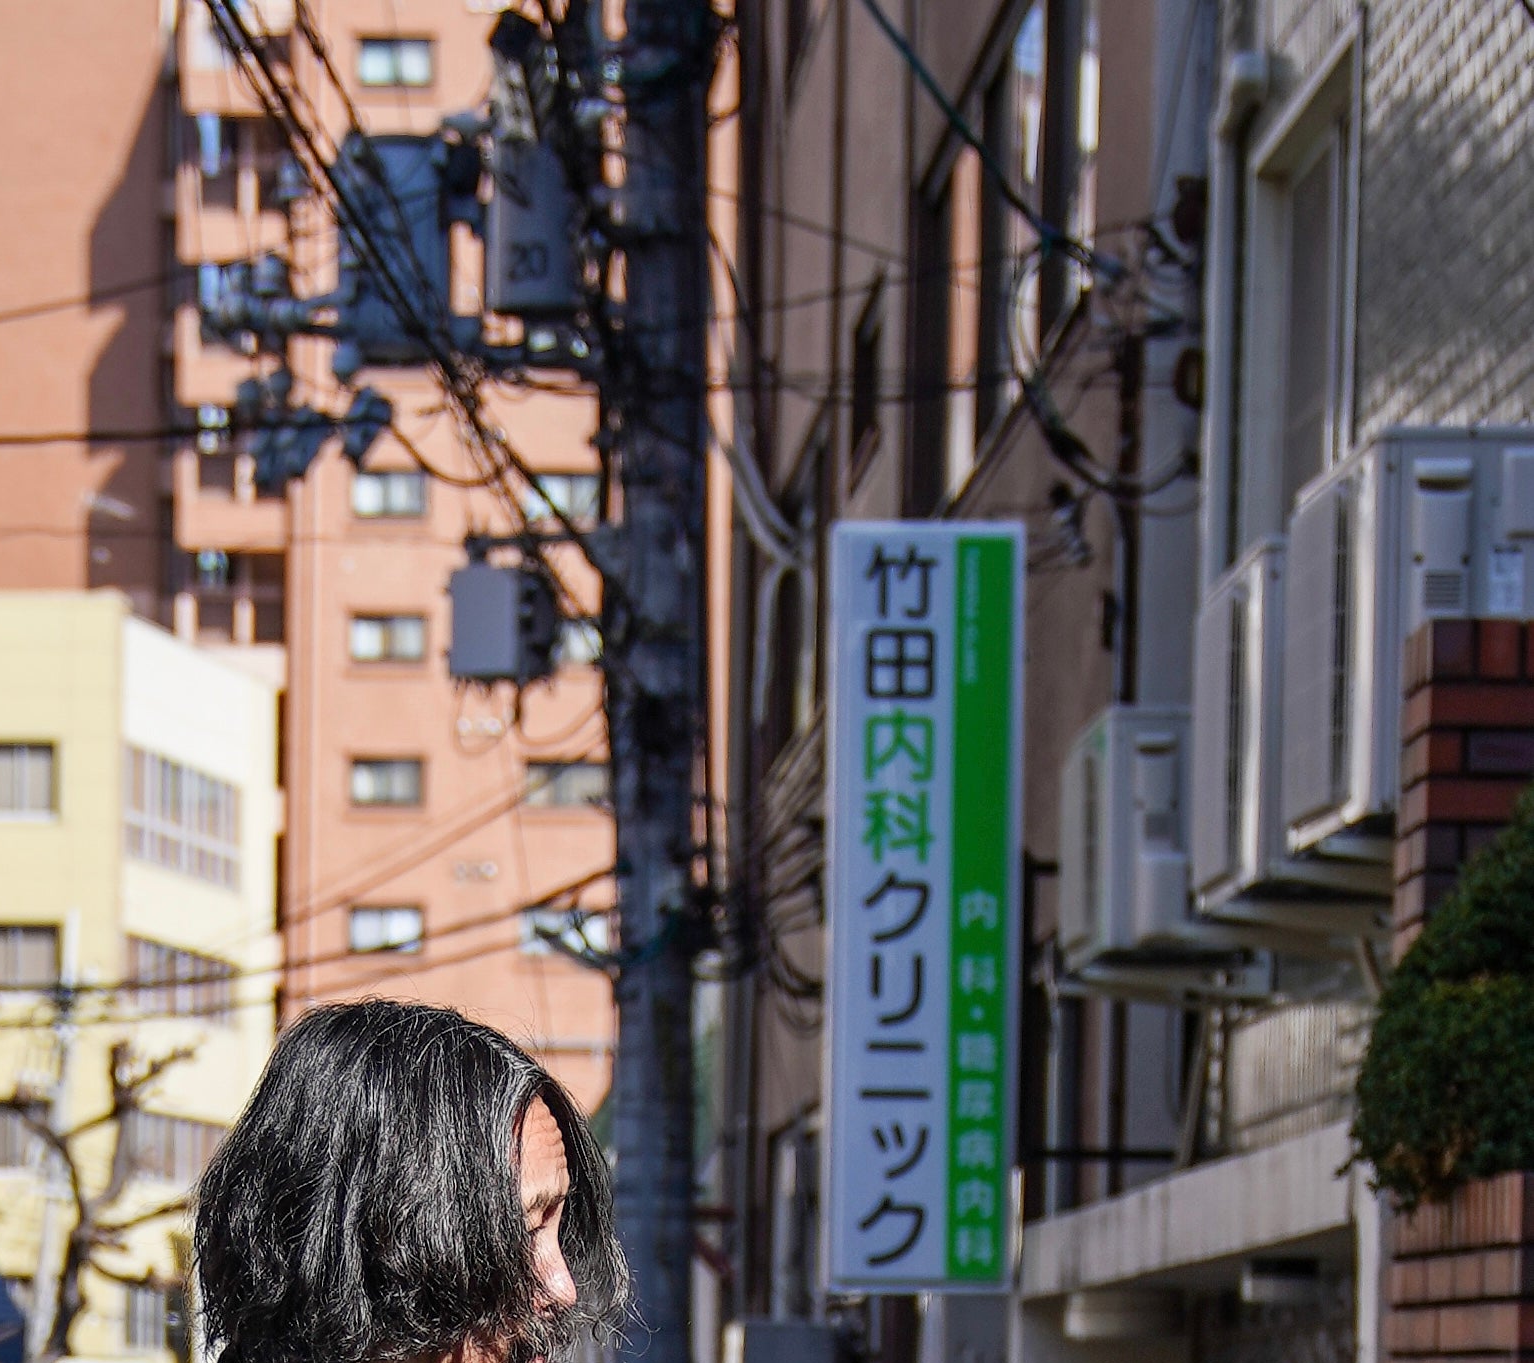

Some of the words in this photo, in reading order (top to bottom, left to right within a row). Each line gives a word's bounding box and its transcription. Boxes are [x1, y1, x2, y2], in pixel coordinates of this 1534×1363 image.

[508, 242, 547, 281] 20
[859, 544, 938, 1266] 竹田内科クリニック
